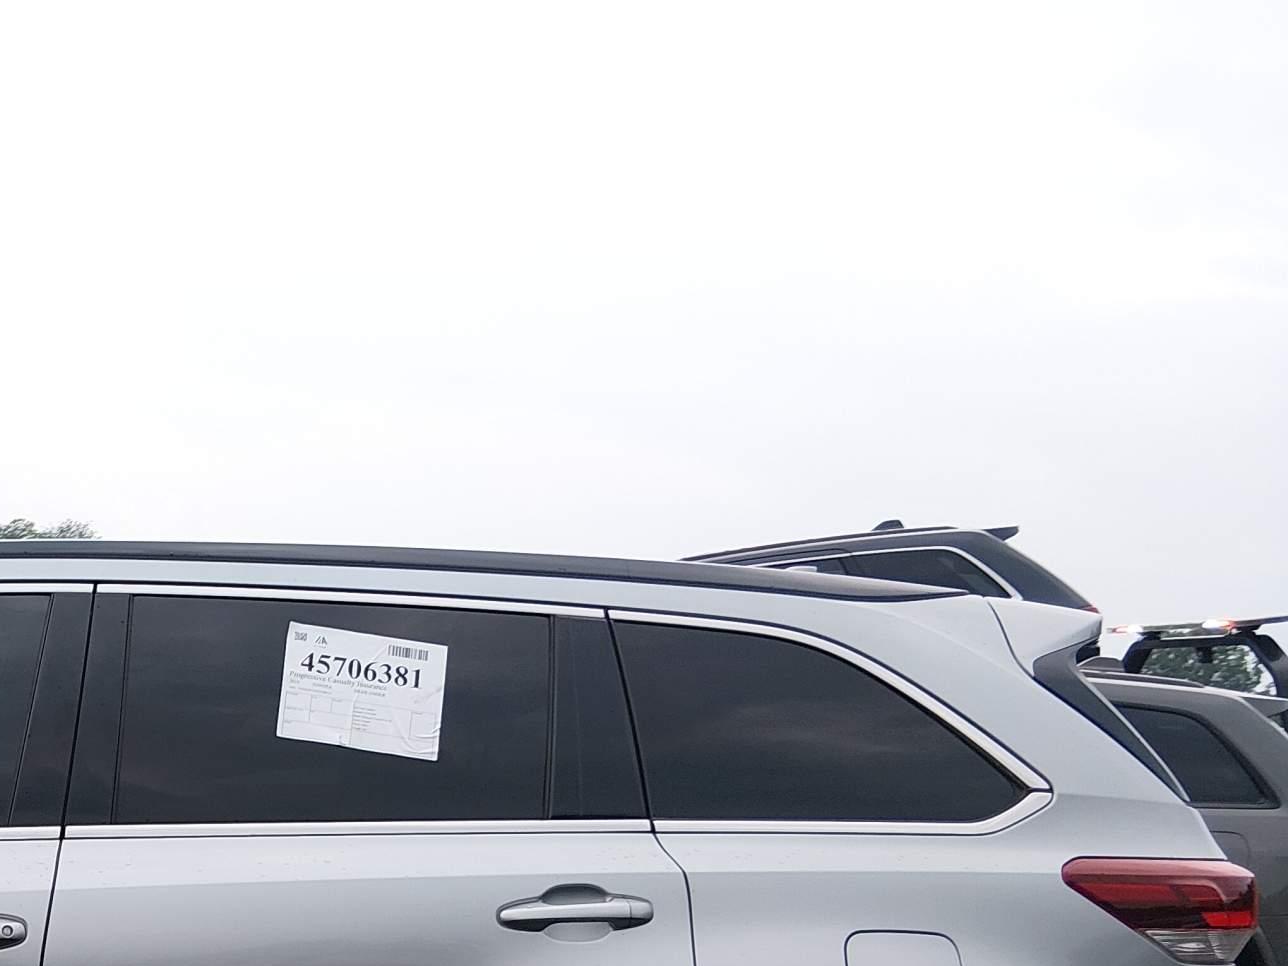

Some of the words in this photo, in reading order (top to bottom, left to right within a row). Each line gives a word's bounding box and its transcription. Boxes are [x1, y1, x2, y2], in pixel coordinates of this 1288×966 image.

[289, 671, 327, 681] Progressive
[327, 677, 356, 688] Casualty
[357, 681, 387, 691] Insurance
[300, 652, 422, 689] 45706381
